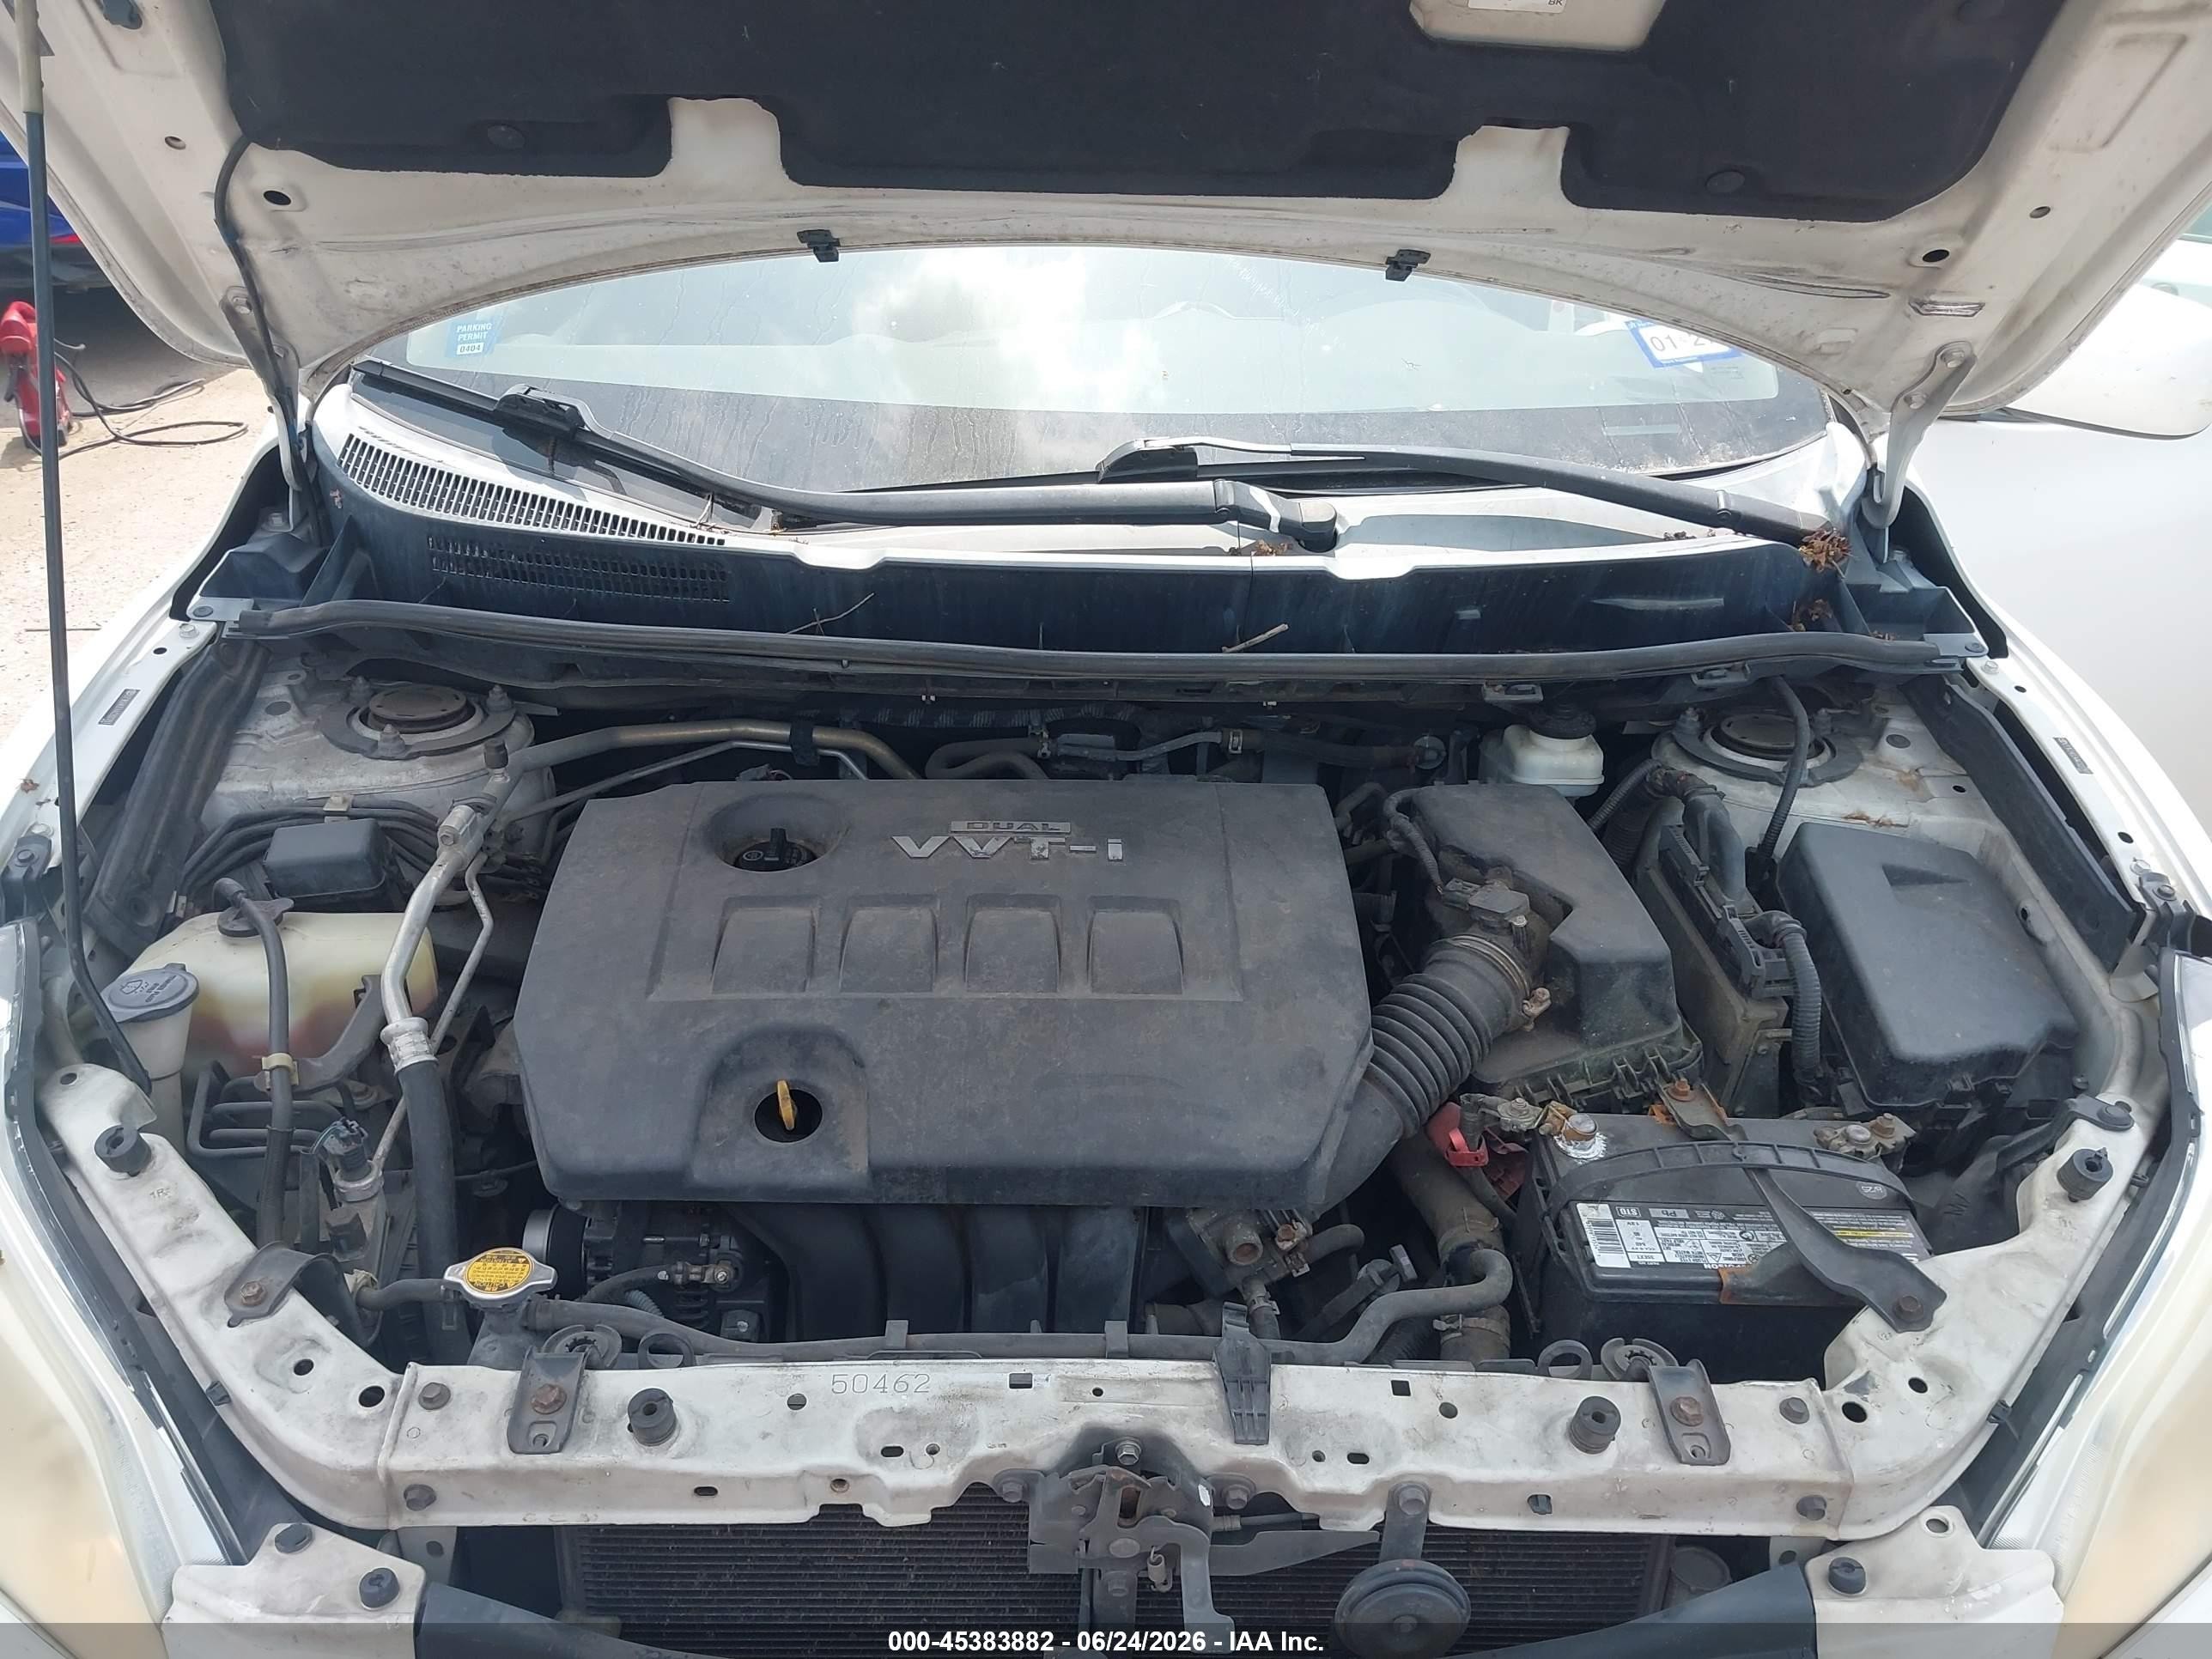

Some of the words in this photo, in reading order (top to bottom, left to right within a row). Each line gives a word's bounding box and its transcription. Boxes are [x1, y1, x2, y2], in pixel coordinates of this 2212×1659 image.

[457, 323, 493, 333] PARKING
[457, 331, 489, 342] PERMIT
[459, 344, 481, 353] 0404
[1650, 335, 1678, 352] 01
[966, 822, 1063, 831] DUAL
[891, 835, 1125, 861] VVT-i
[830, 1373, 930, 1394] 50462
